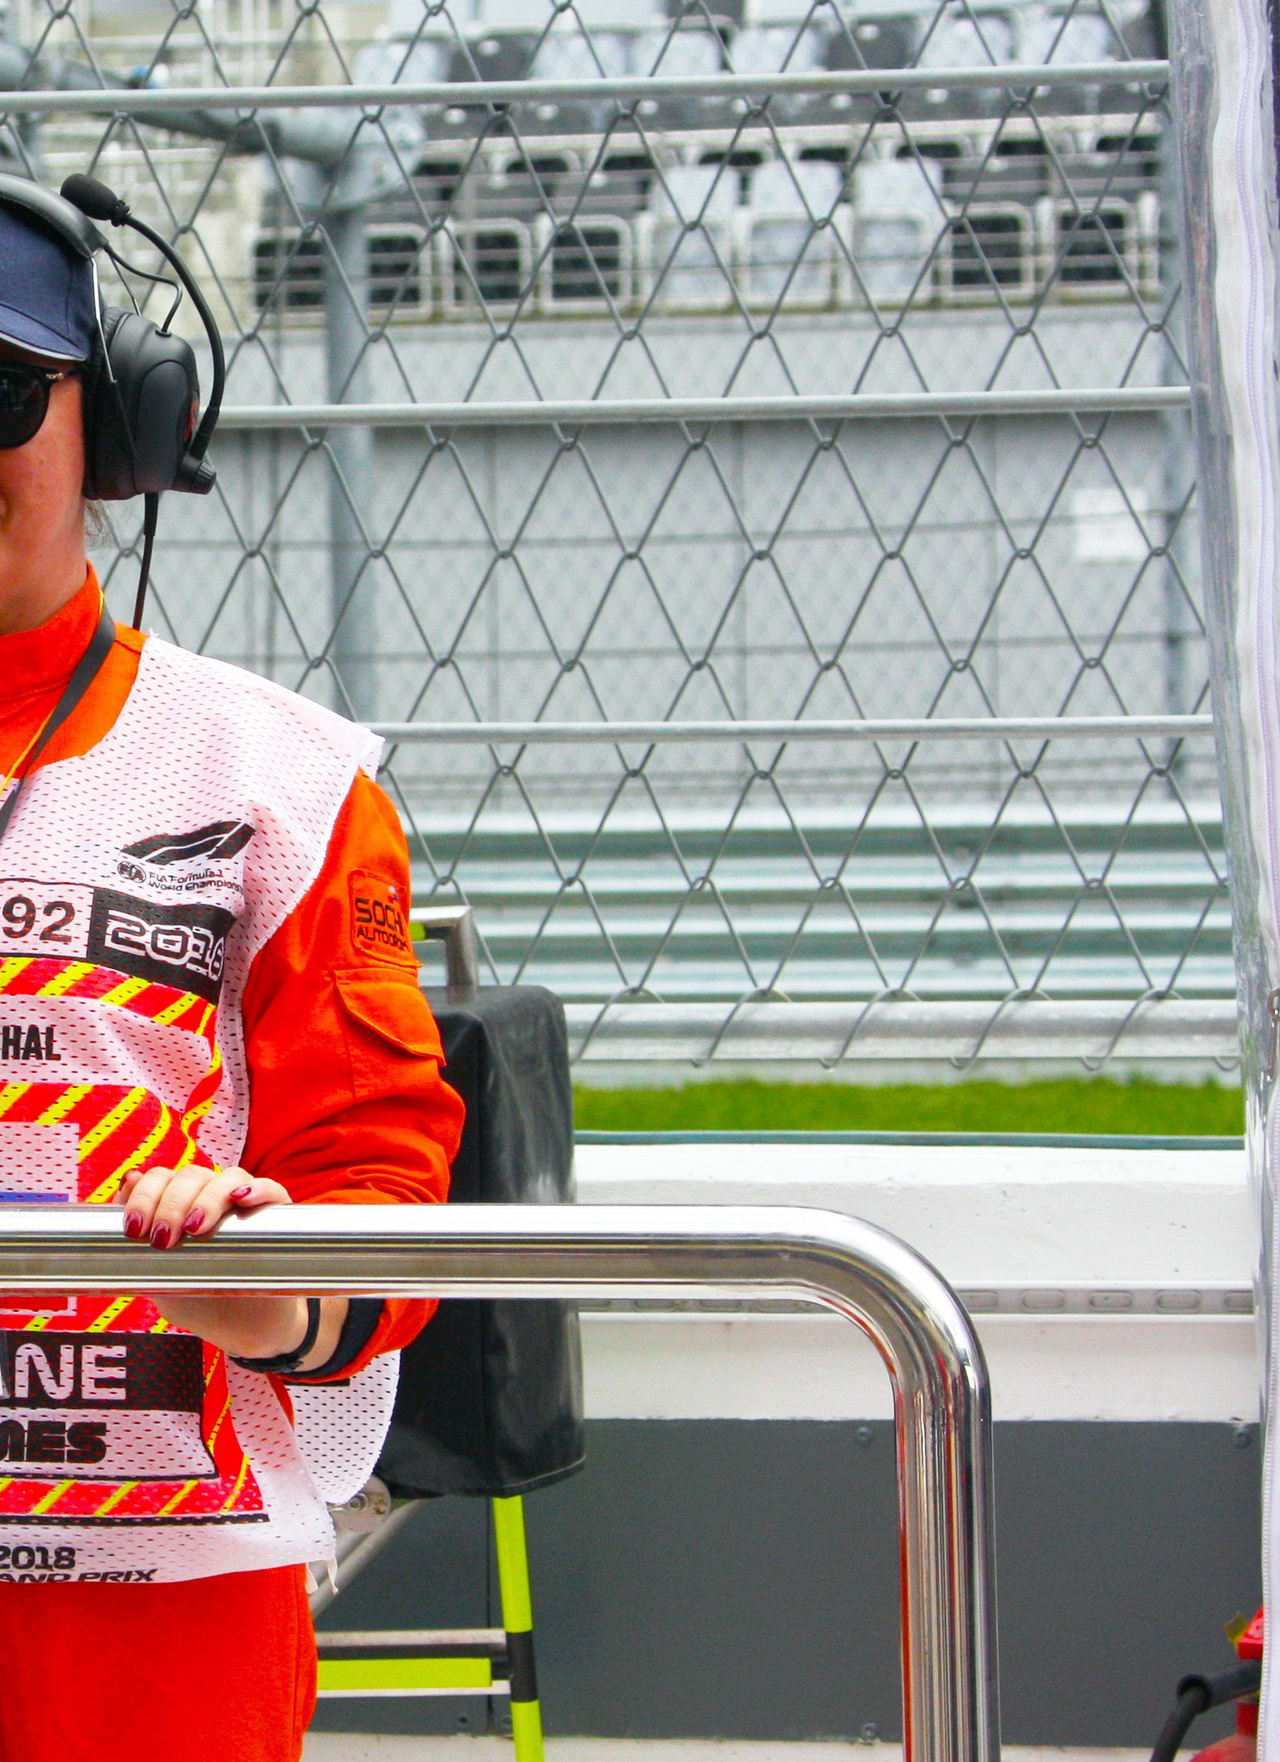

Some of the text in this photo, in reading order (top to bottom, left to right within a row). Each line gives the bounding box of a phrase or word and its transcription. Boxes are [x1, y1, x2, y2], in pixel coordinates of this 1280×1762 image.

[169, 869, 218, 884] Formula
[148, 881, 183, 891] World
[14, 1343, 128, 1399] NE
[77, 1568, 158, 1583] PRIX
